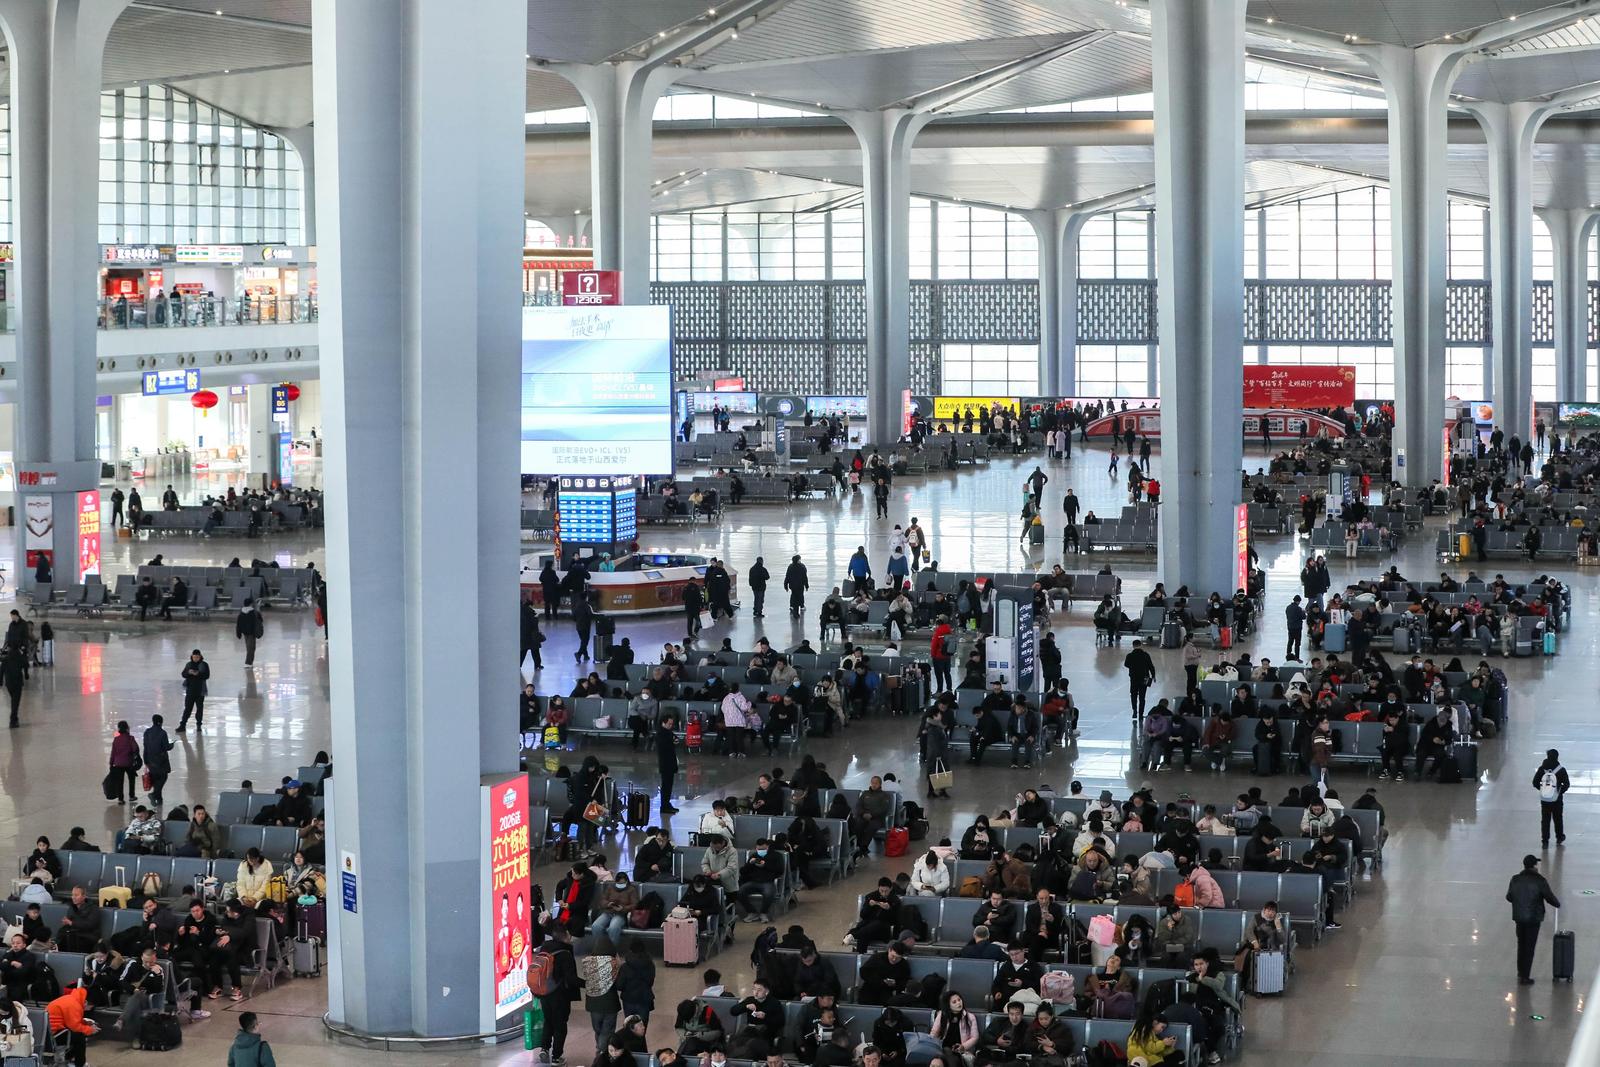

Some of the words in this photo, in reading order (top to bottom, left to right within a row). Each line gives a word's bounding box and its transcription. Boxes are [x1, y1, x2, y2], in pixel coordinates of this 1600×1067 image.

[575, 296, 603, 304] 12306
[493, 824, 529, 862] 六个核桃
[493, 853, 529, 891] 六六大顺
